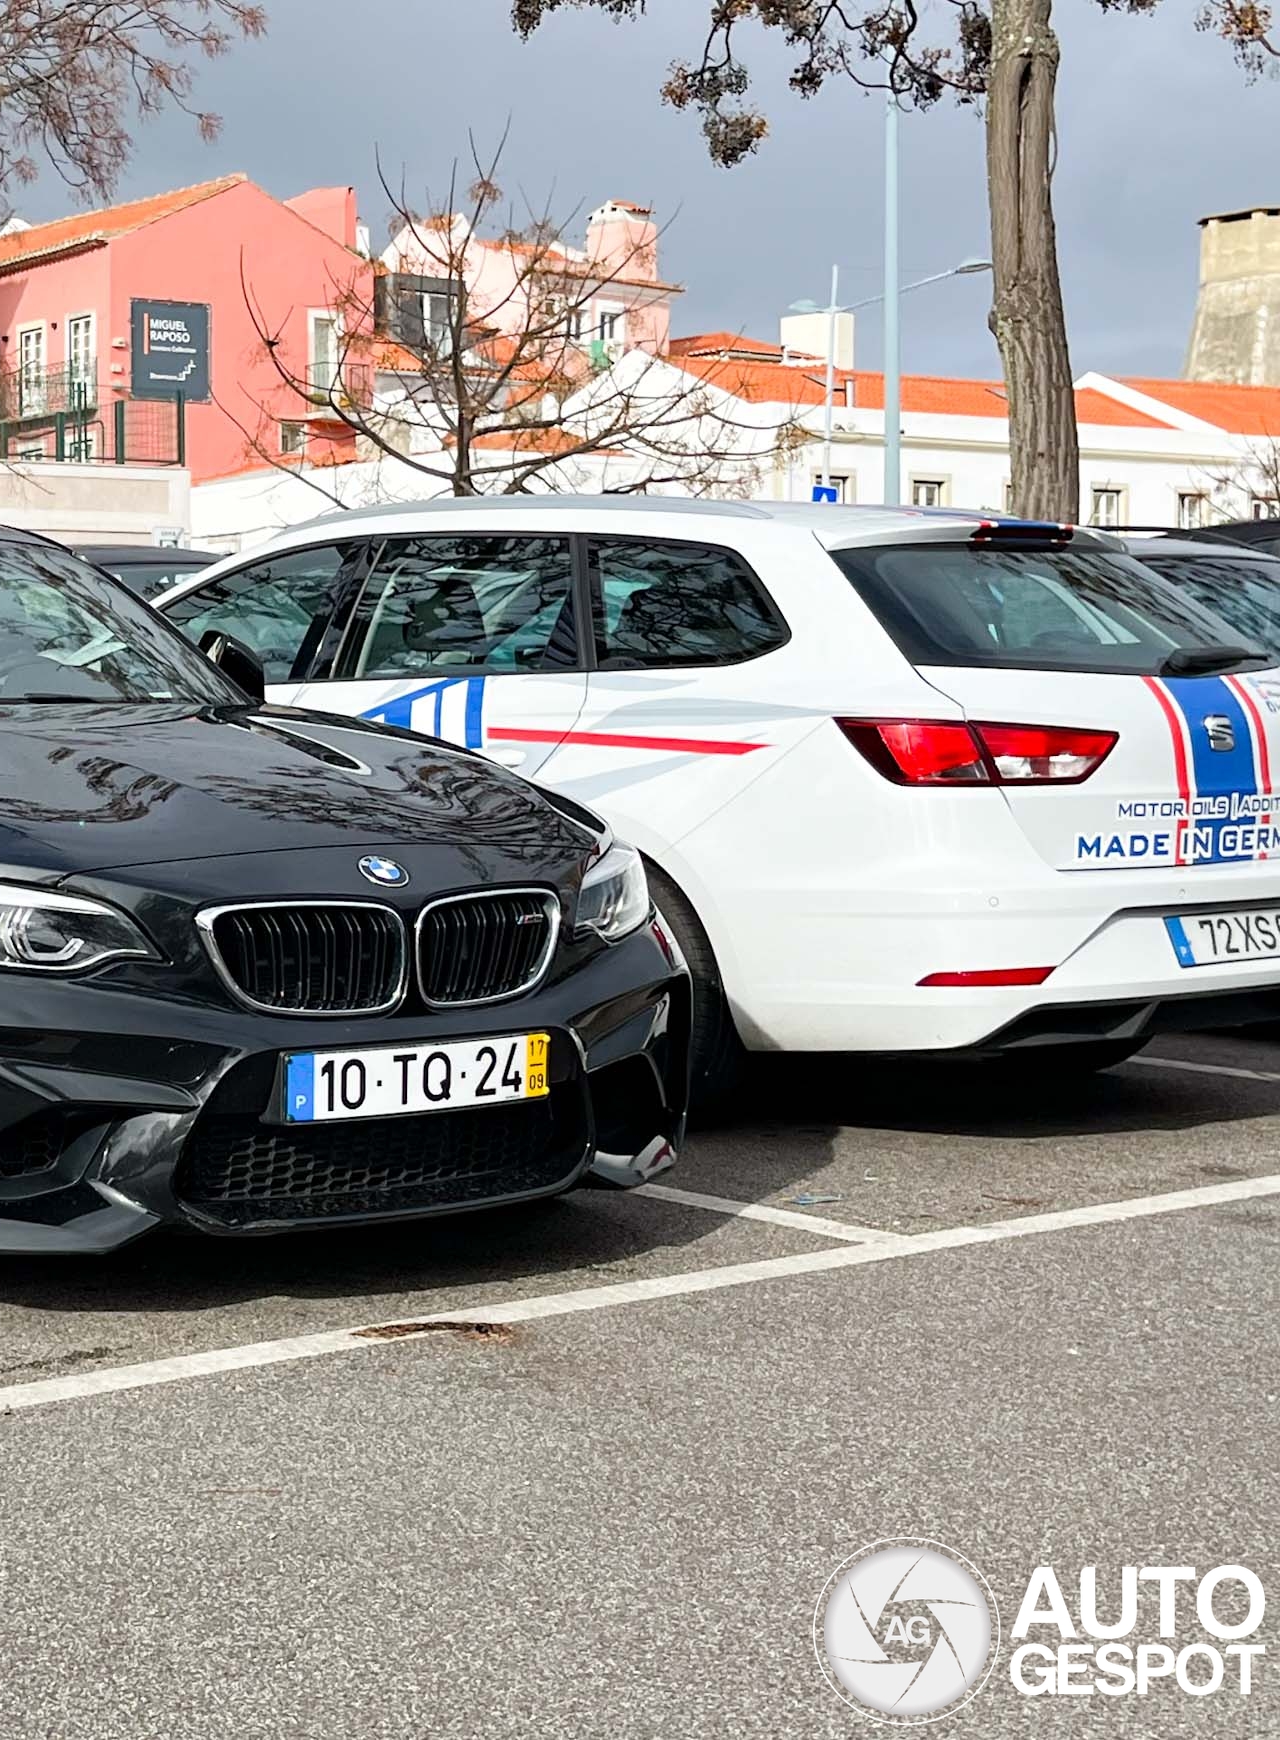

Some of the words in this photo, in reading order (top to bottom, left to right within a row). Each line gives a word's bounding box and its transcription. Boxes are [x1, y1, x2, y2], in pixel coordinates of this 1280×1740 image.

[150, 318, 188, 331] MIGUEL
[150, 331, 191, 343] RAPOSO
[1119, 802, 1185, 817] MOTOR
[1192, 800, 1227, 815] OILS
[1078, 833, 1170, 858] MADE
[1183, 830, 1210, 857] IN
[1198, 914, 1280, 955] 72XS
[530, 1040, 544, 1056] 17
[530, 1073, 544, 1089] 09
[295, 1094, 307, 1109] P
